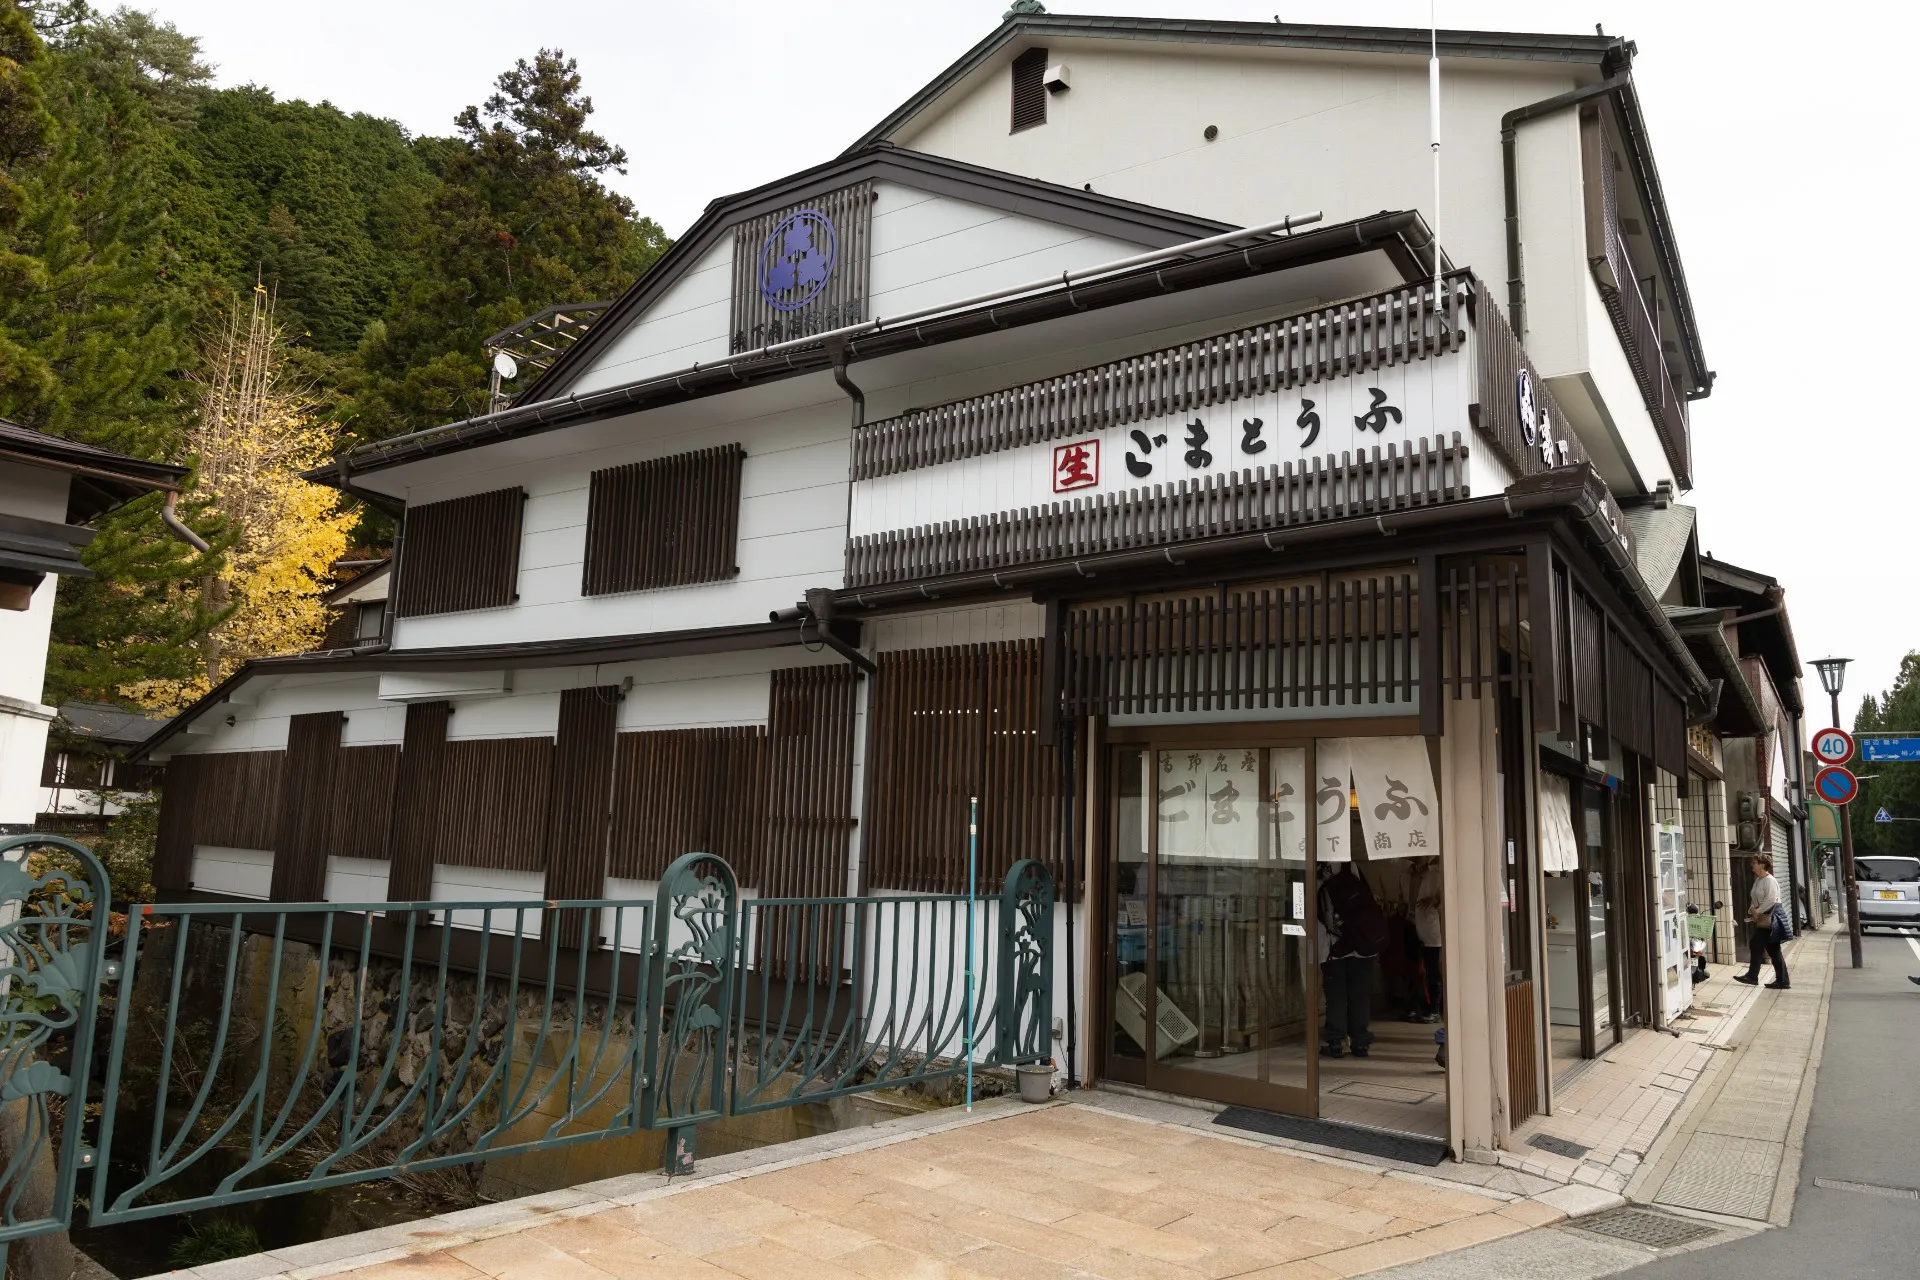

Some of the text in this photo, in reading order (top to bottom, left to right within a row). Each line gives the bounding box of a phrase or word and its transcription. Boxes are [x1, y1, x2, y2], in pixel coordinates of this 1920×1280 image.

[1058, 387, 1403, 486] 生 ごまとうふ
[1821, 738, 1845, 755] 40
[1159, 774, 1429, 825] ごまとうふ
